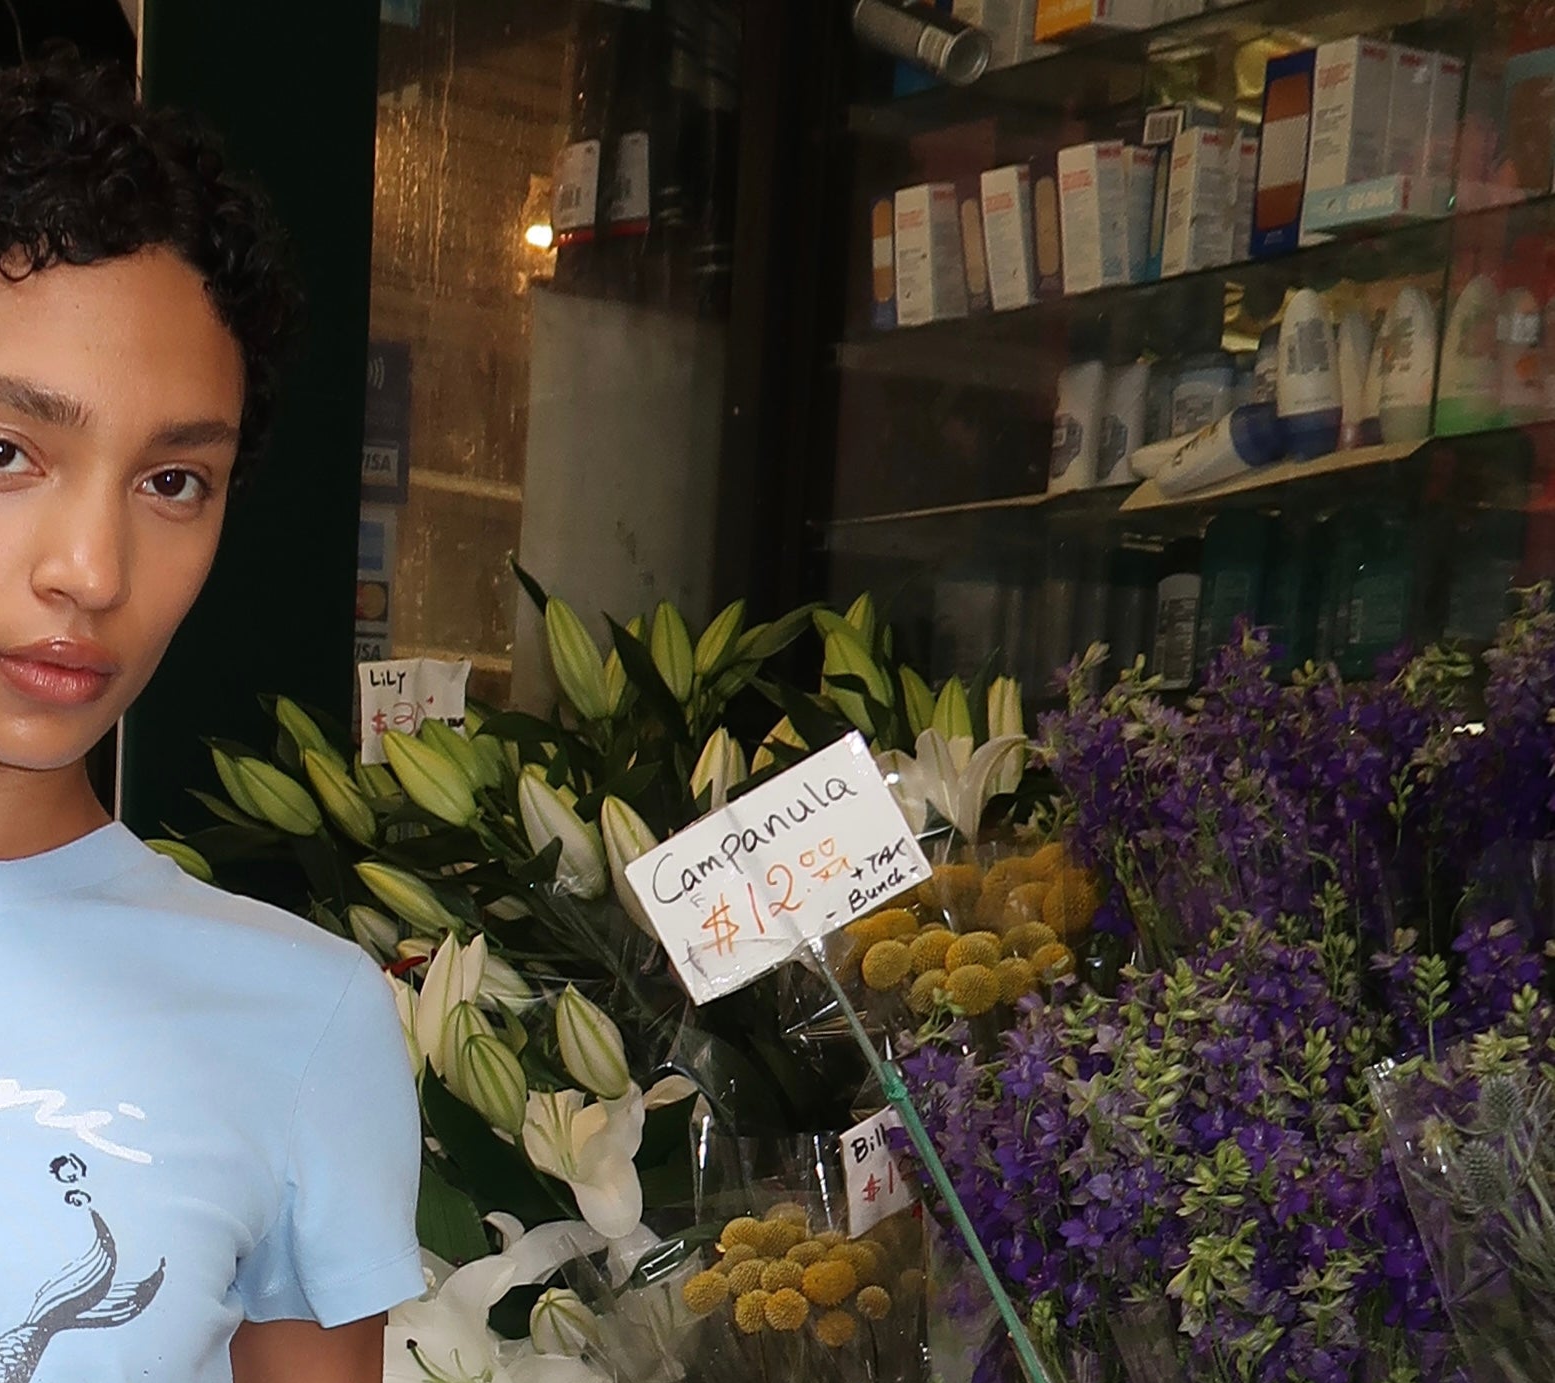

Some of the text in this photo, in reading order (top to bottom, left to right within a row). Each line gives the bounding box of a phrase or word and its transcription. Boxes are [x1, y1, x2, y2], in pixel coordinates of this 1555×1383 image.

[364, 453, 392, 473] ISA
[355, 643, 381, 660] ISA
[652, 777, 858, 904] Campanula
